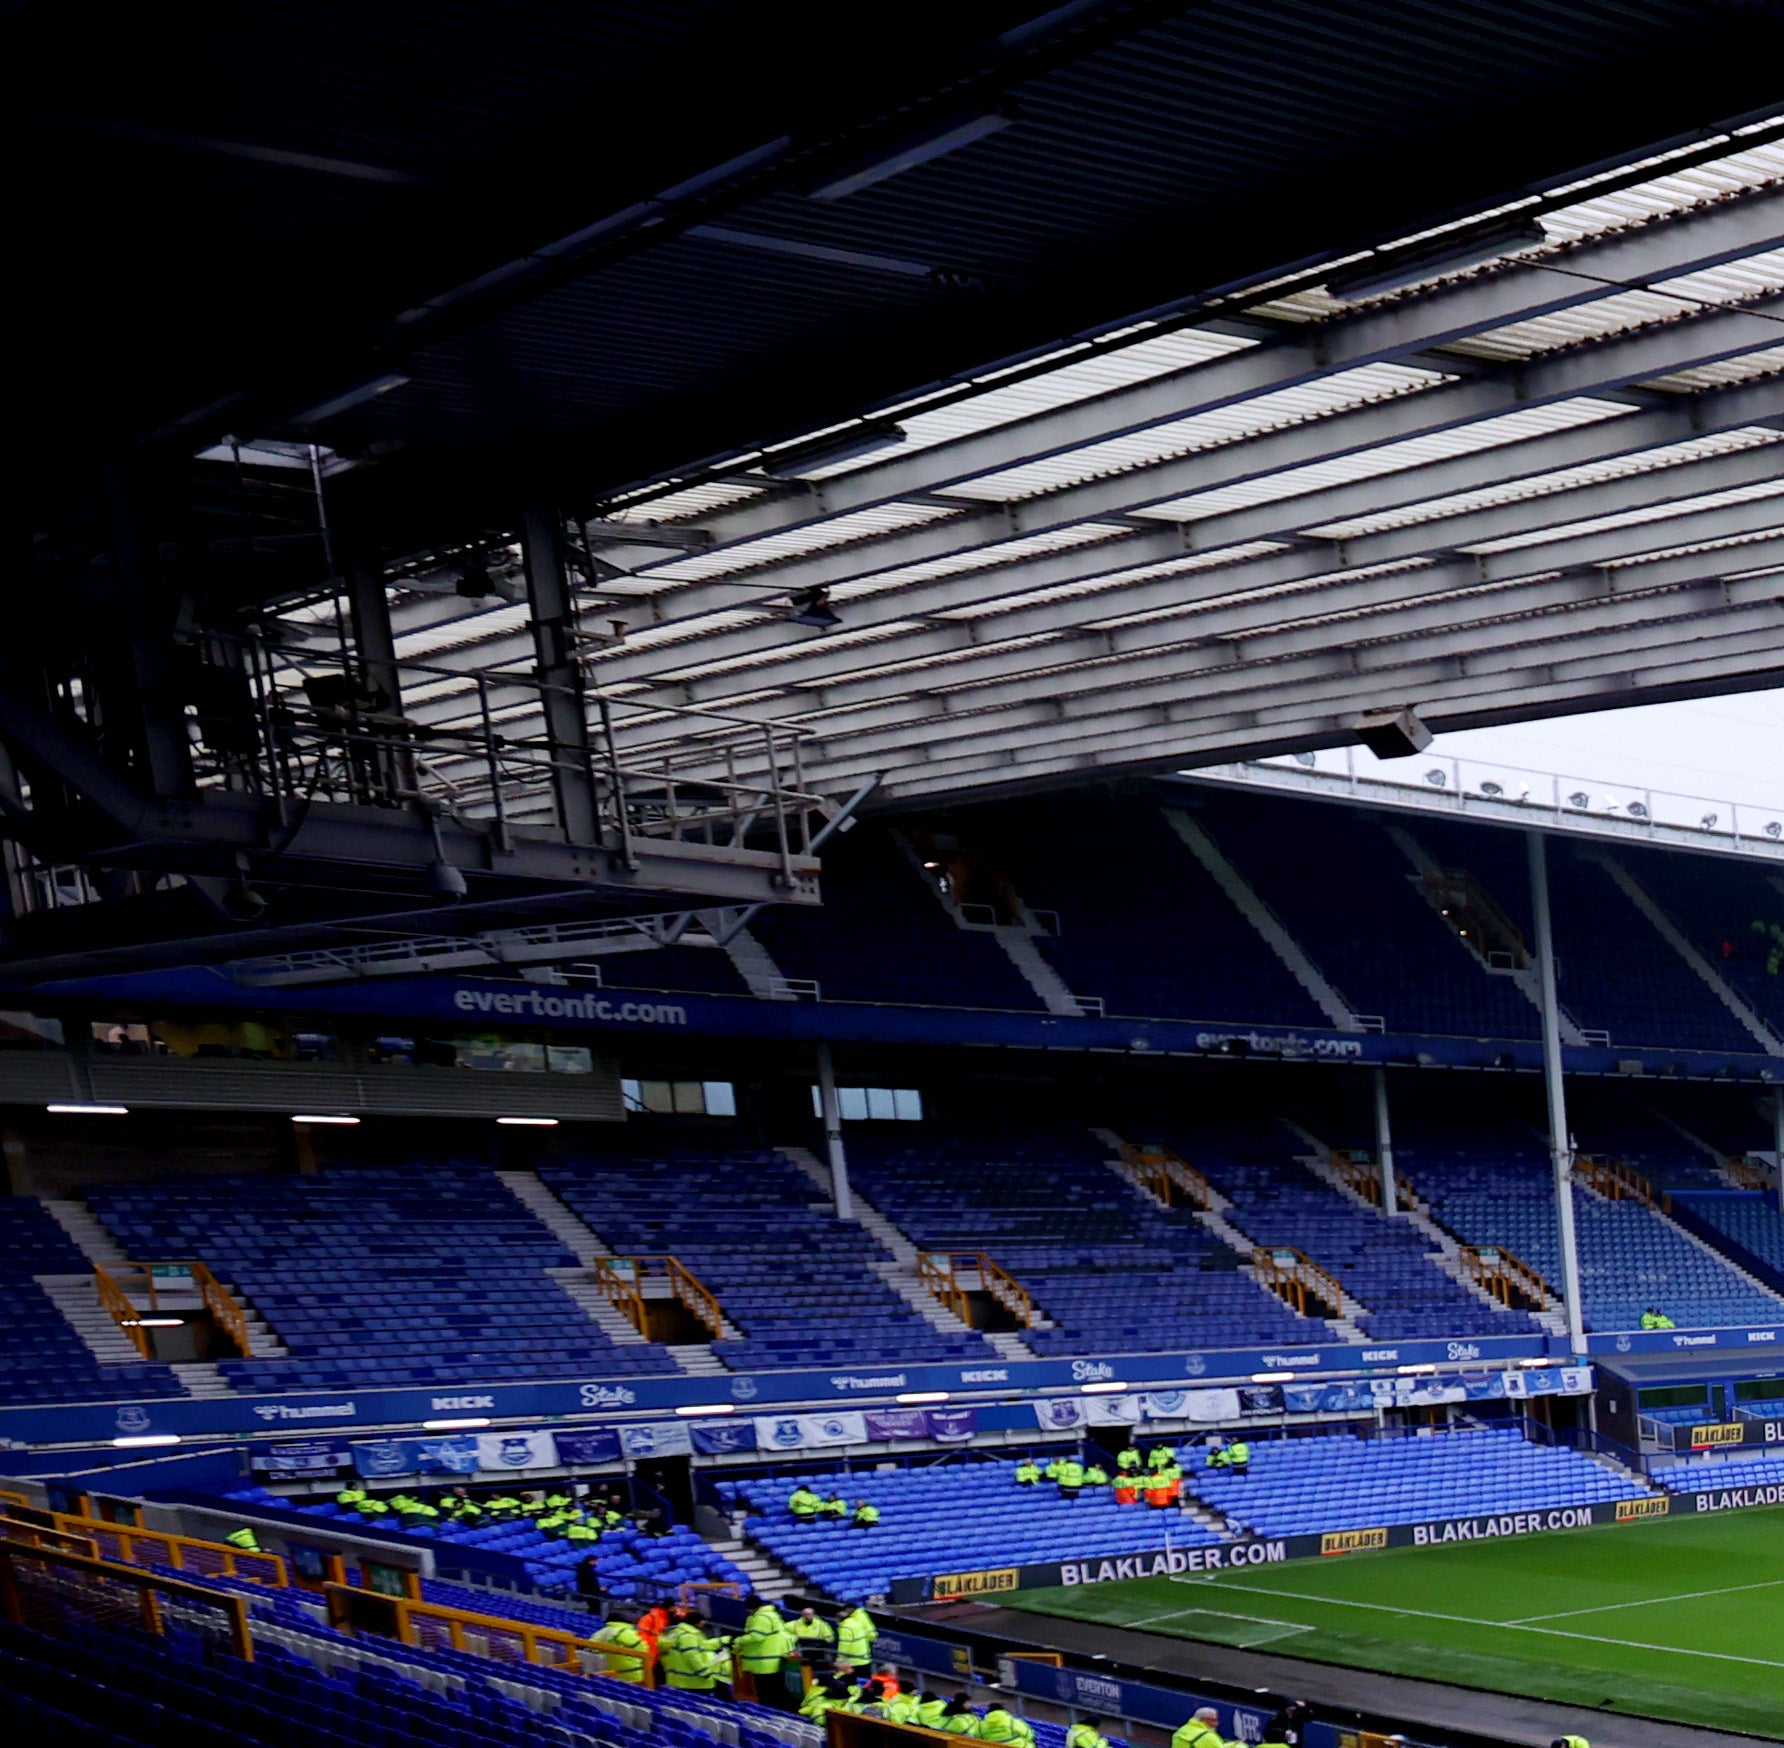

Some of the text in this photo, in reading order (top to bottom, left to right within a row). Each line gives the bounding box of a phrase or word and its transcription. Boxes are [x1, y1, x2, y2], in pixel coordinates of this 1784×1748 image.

[454, 989, 688, 1025] evertonfc.com
[1748, 1331, 1775, 1342] KICK
[1362, 1350, 1398, 1362] KICK
[1447, 1343, 1481, 1360] Stake
[1275, 1354, 1321, 1368] hummel
[961, 1369, 1009, 1384] KICK
[1072, 1360, 1115, 1381] Stake
[849, 1374, 907, 1390] hummel
[431, 1395, 495, 1411] KICK
[580, 1384, 638, 1408] Stake
[281, 1402, 356, 1419] hummel
[1413, 1507, 1593, 1546] BLAKLADER.COM
[1061, 1541, 1287, 1587] BLAKLADER.COM
